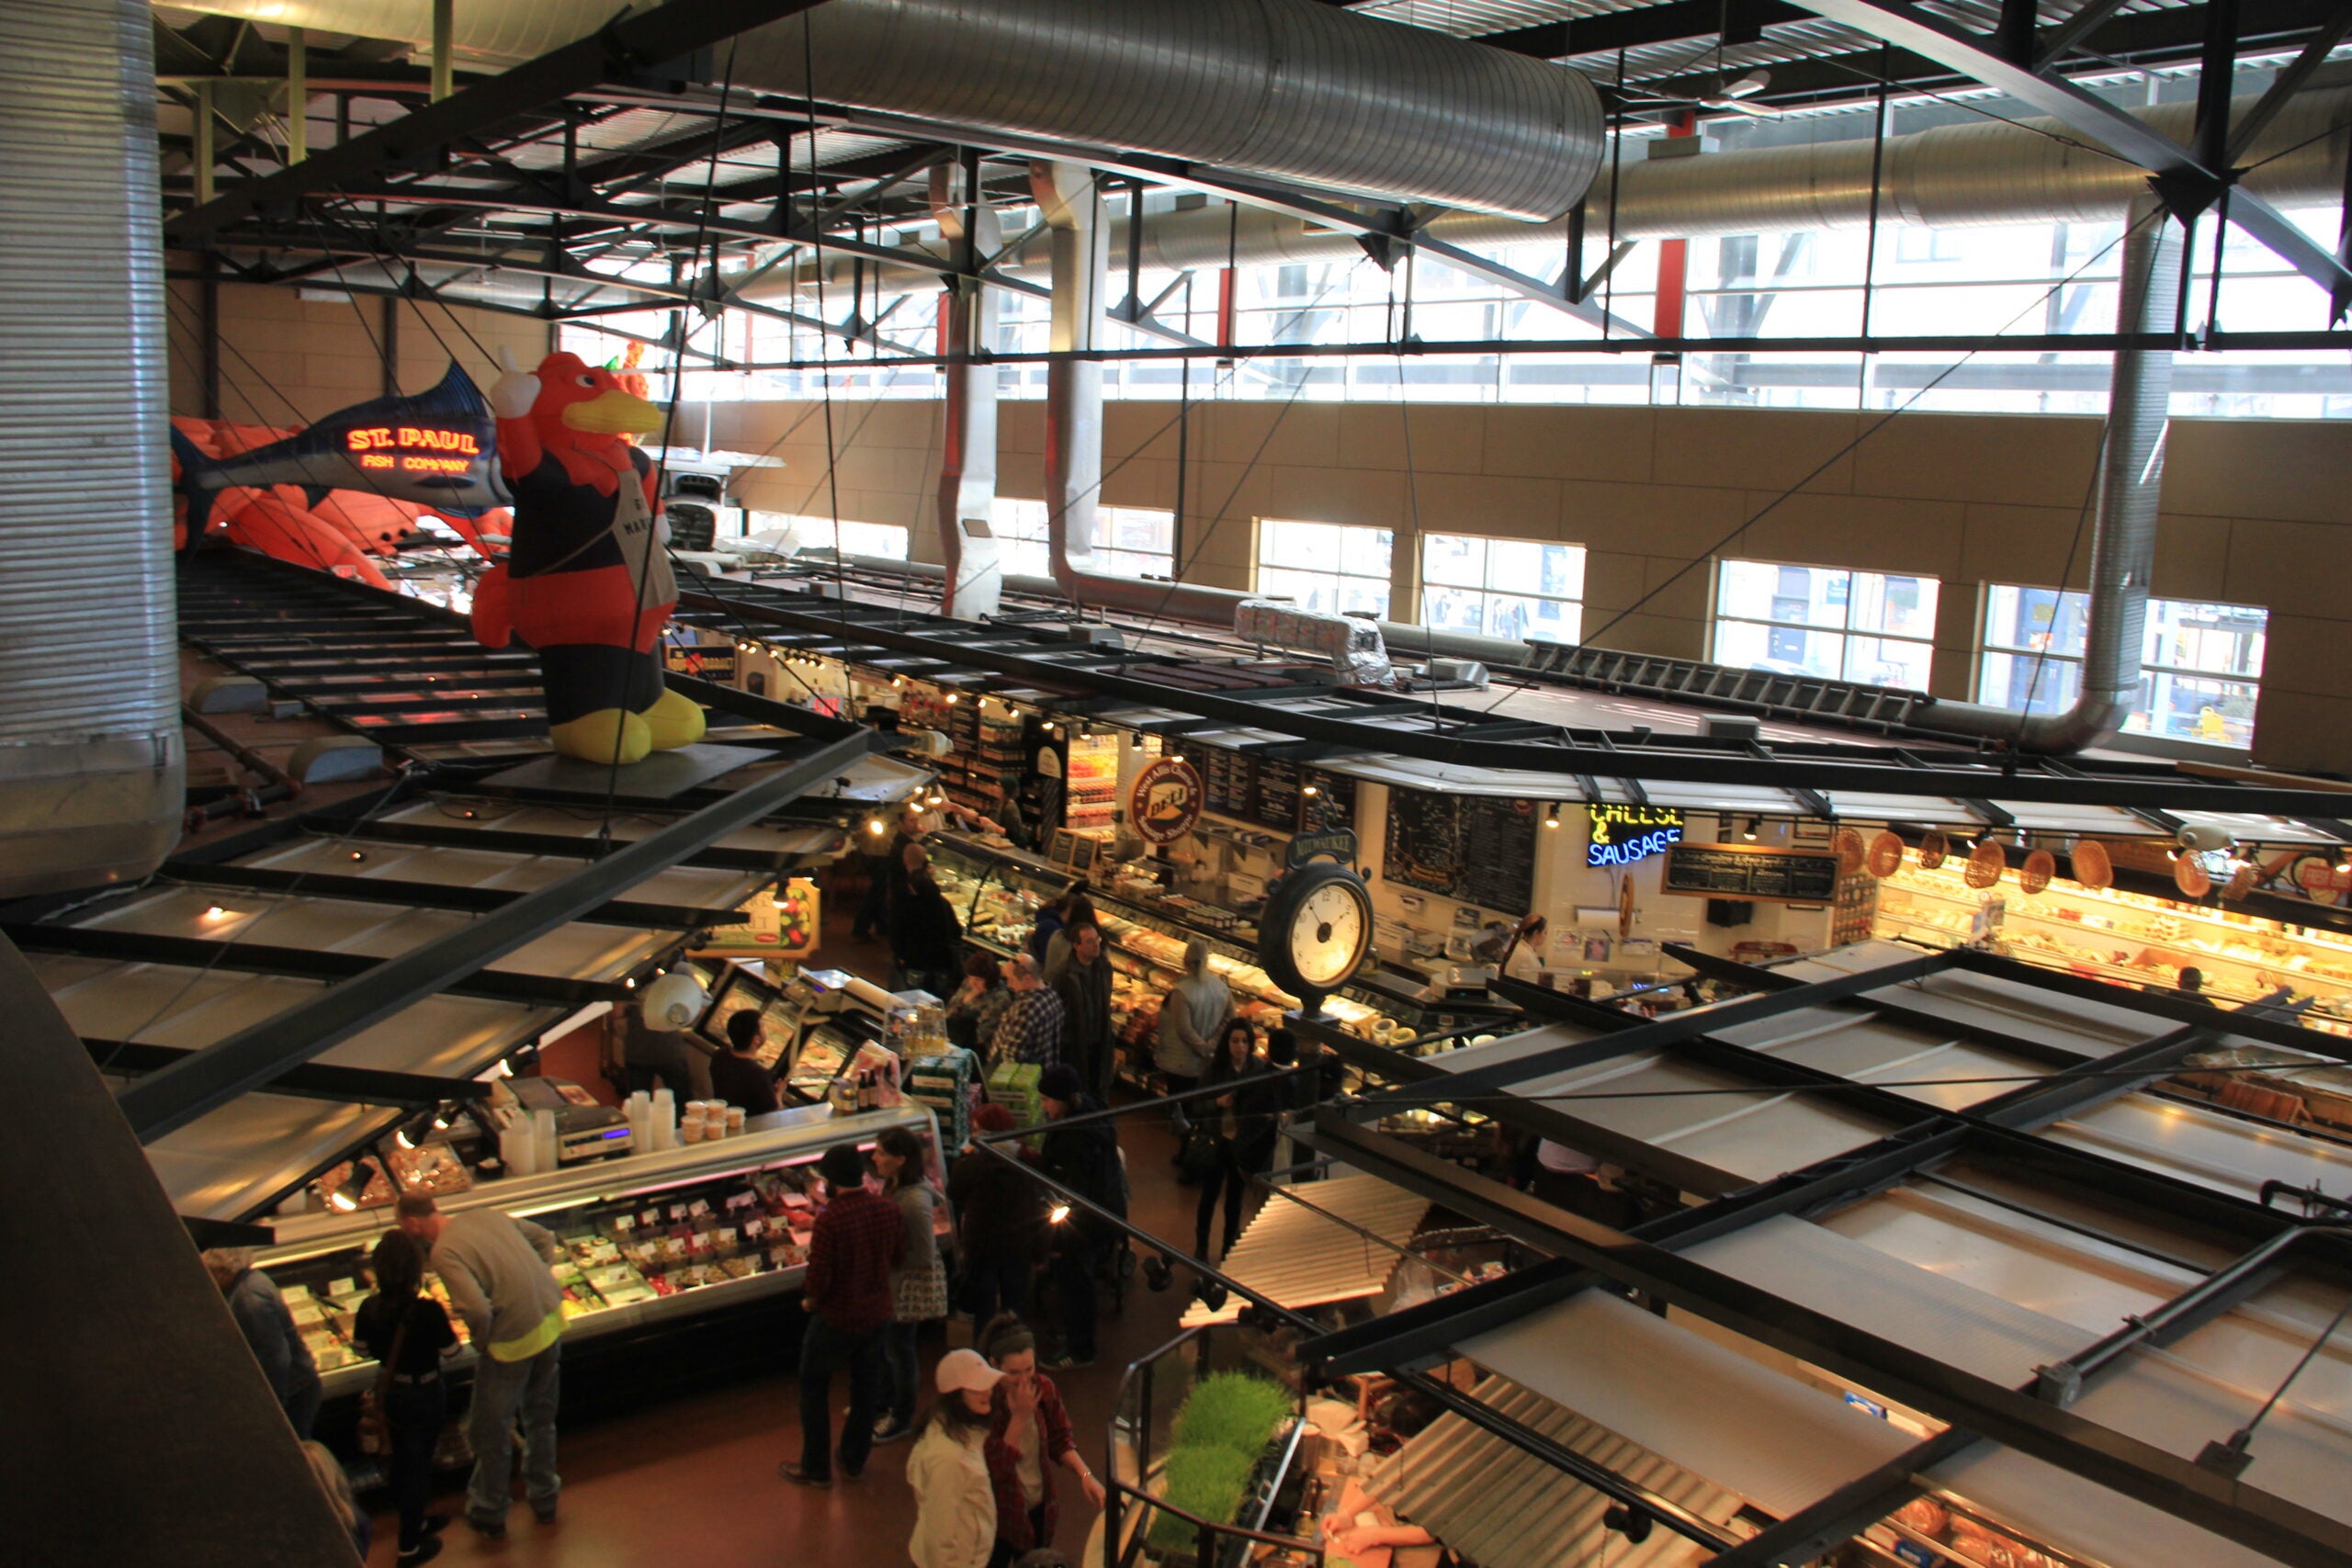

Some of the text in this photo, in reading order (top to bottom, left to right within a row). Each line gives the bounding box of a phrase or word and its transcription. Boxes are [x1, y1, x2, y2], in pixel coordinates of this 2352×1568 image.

[348, 427, 480, 454] ST. PAUL
[362, 455, 470, 472] FISH COMPANY
[1151, 788, 1183, 817] DELI
[1592, 821, 1610, 843] &
[1296, 834, 1351, 856] MILWAUKEE
[1587, 829, 1681, 865] SAUSAGE
